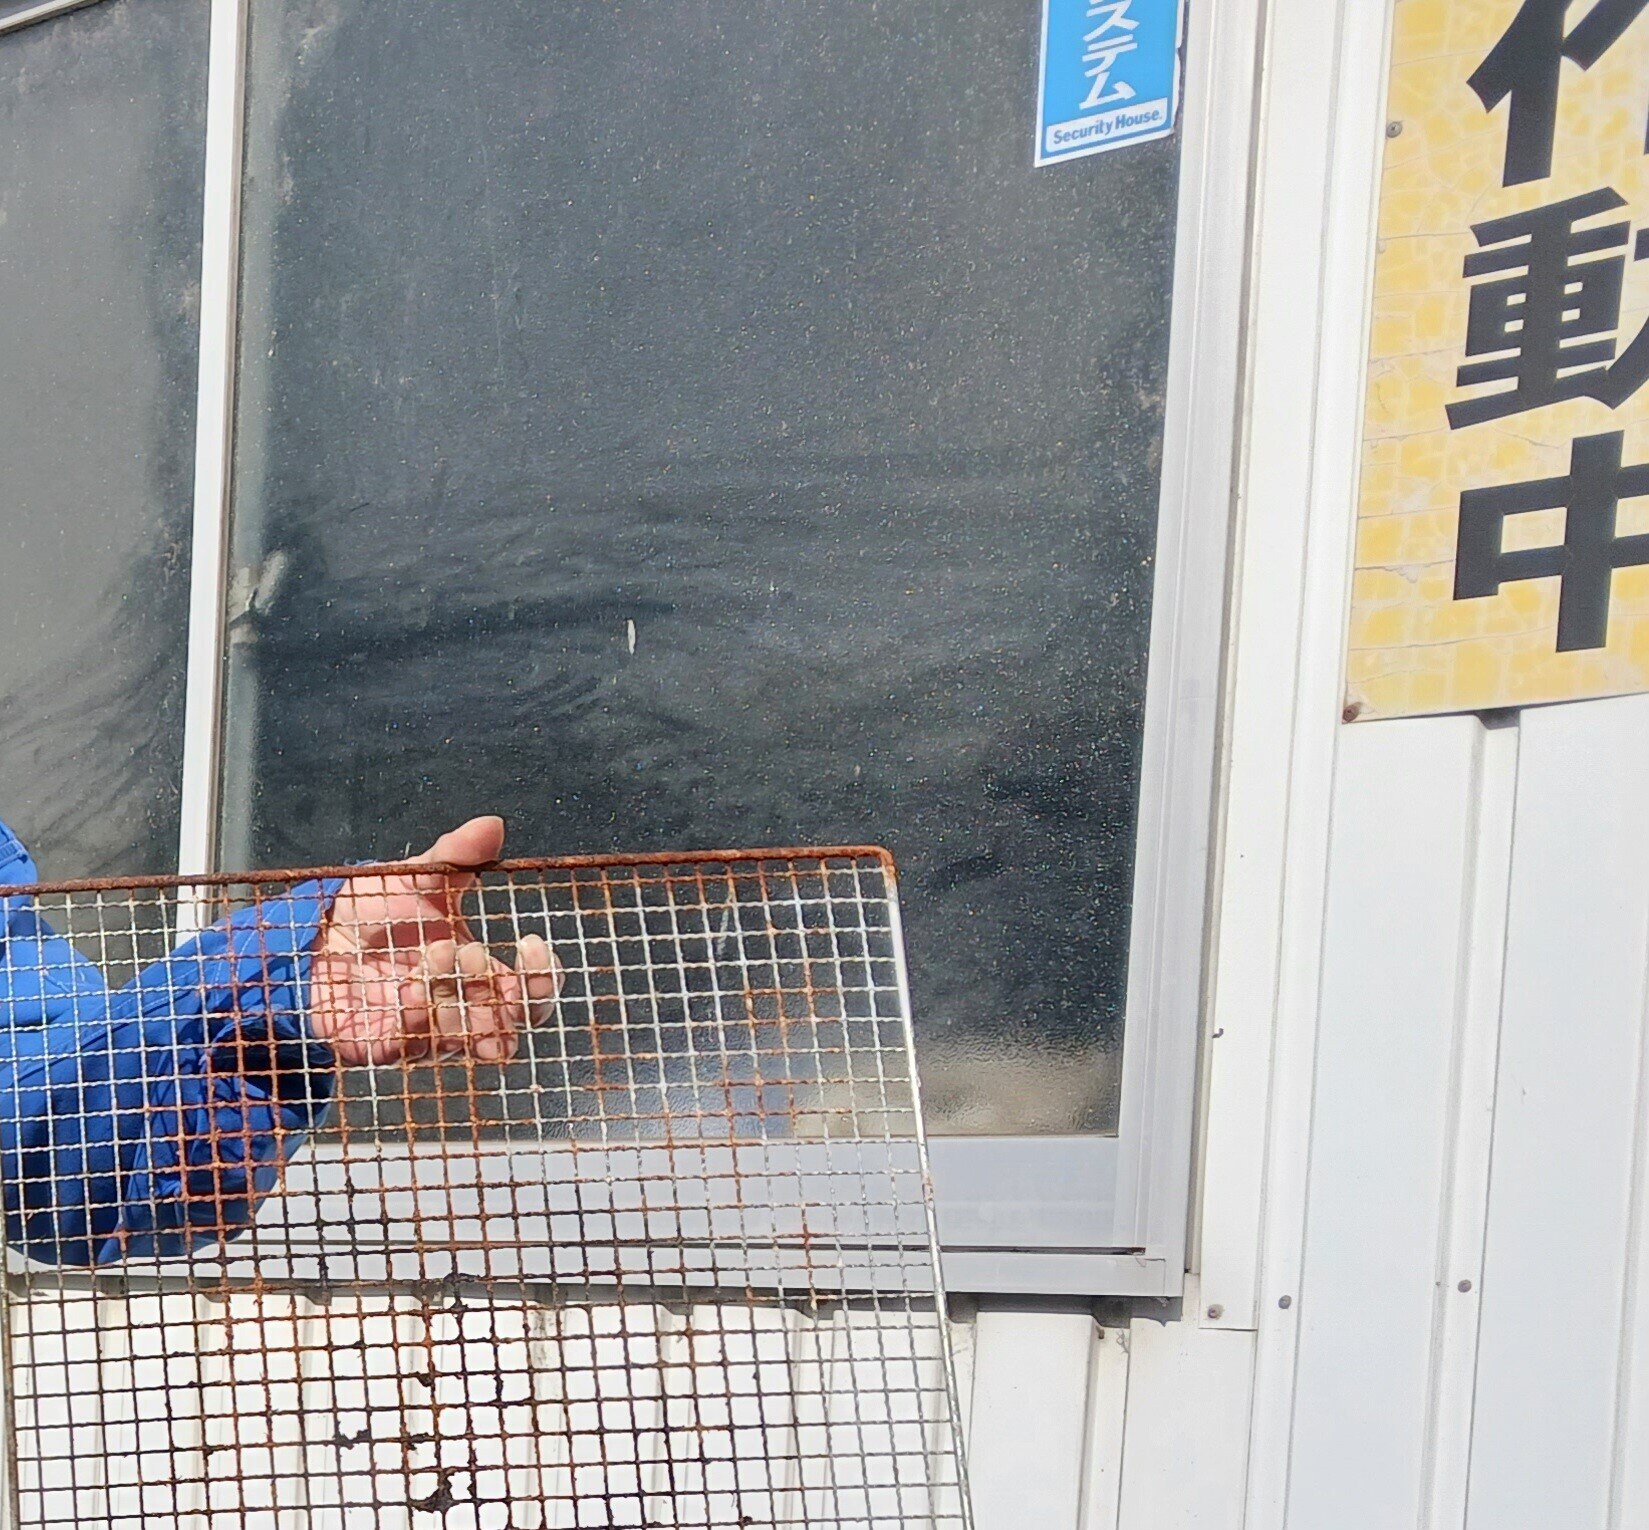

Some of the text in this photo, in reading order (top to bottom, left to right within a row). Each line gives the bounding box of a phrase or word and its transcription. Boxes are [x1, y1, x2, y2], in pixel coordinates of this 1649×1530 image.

[1079, 0, 1140, 110] ステム
[1053, 119, 1114, 145] Security
